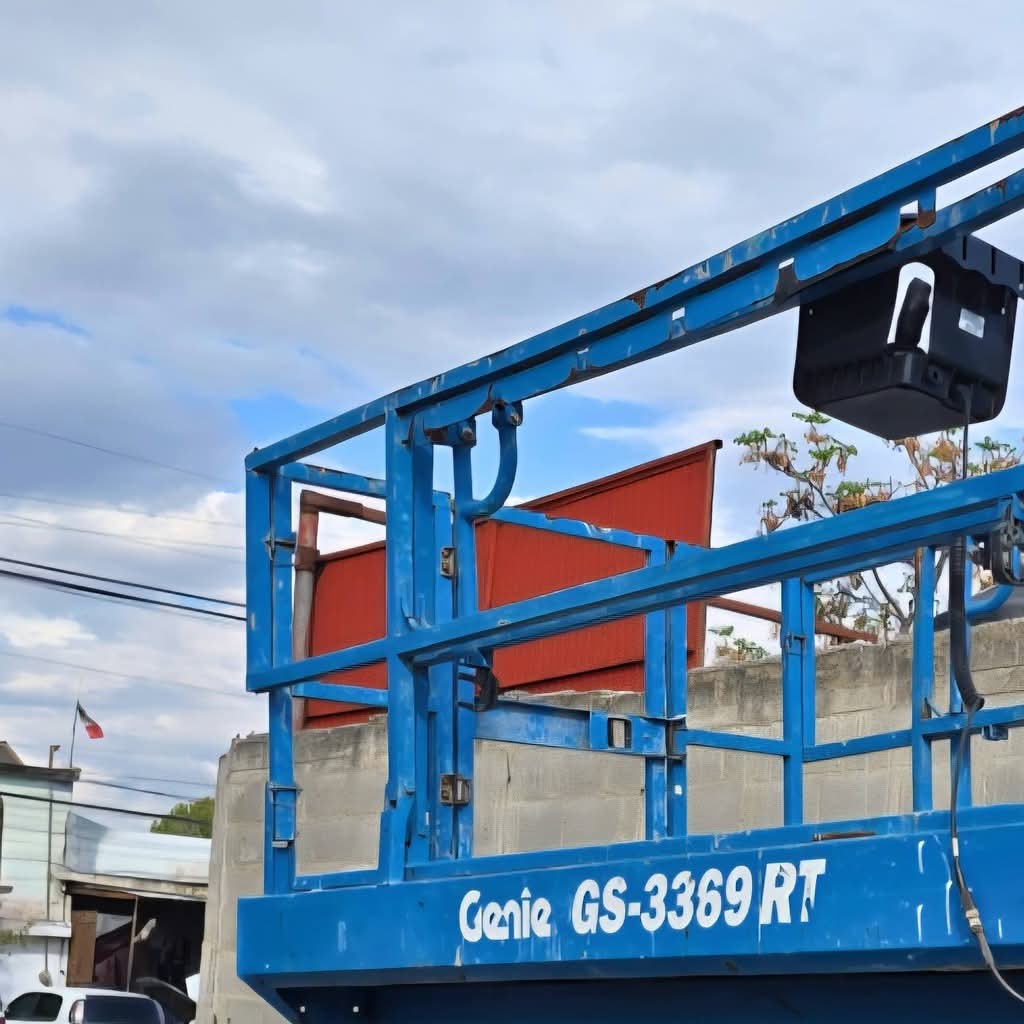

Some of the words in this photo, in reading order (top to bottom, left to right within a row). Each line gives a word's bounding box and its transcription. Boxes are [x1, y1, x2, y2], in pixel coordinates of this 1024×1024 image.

[459, 887, 552, 943] Genie
[571, 865, 753, 935] GS-3369
[760, 859, 827, 925] RT
